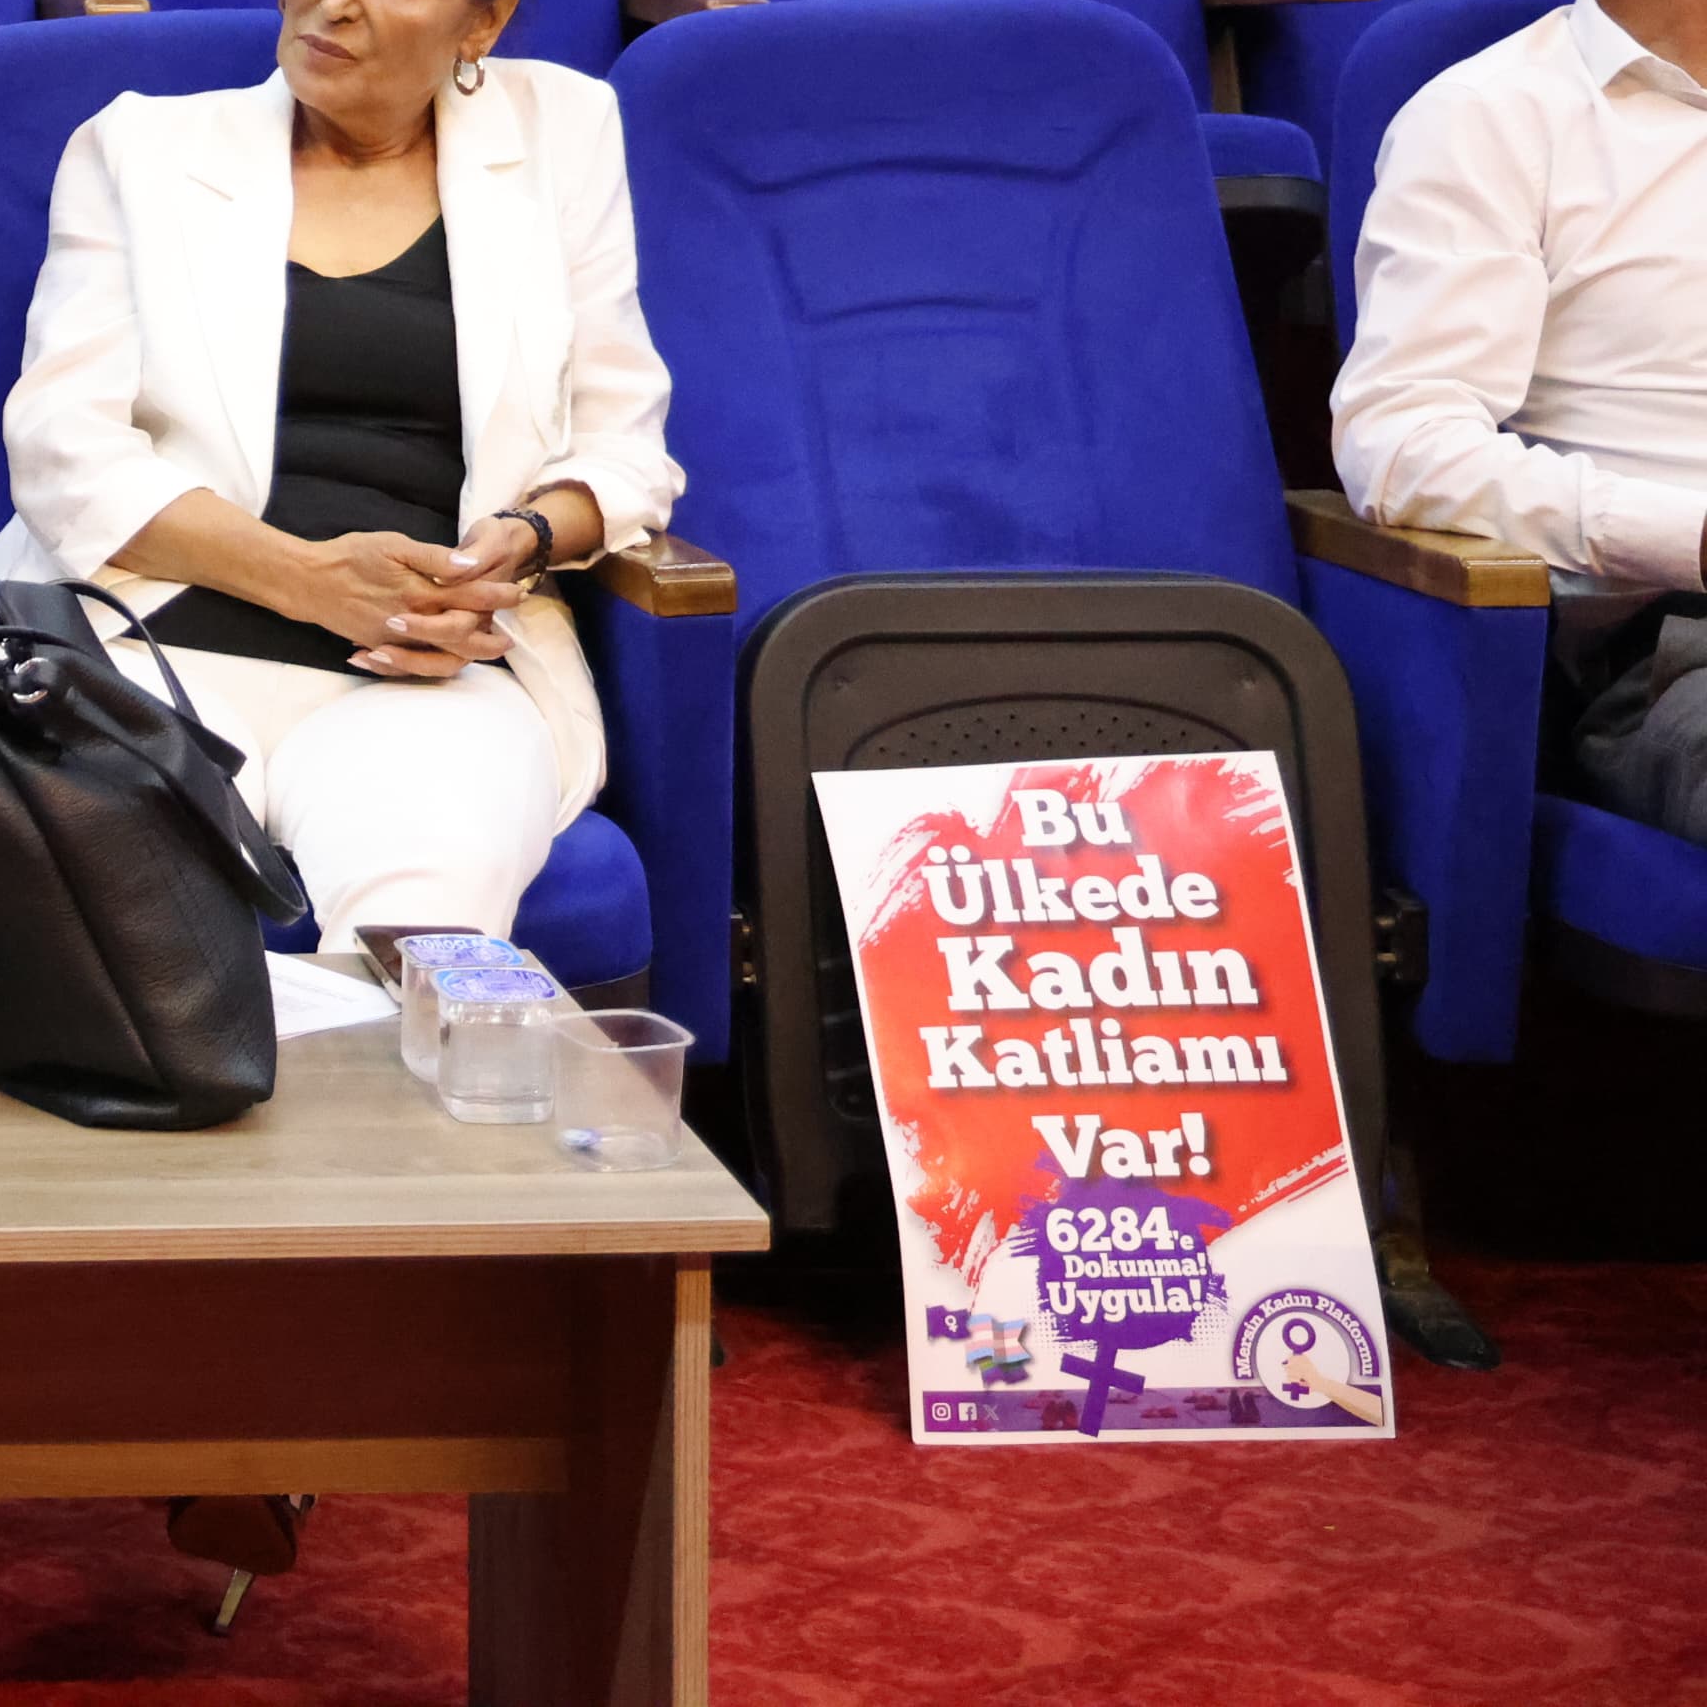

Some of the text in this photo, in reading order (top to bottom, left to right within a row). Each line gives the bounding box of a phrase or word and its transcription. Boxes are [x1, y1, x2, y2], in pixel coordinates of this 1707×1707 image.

[1010, 788, 1132, 847] Bu
[920, 844, 1220, 926] Ülkede
[936, 926, 1259, 1011] Kadın
[918, 1017, 1288, 1089] Katliamı
[1030, 1112, 1212, 1179] Var!
[1062, 1252, 1208, 1279] Dokunma!
[1046, 1277, 1204, 1324] Uygula!
[1236, 1292, 1373, 1378] Mersin Kadın Platformu
